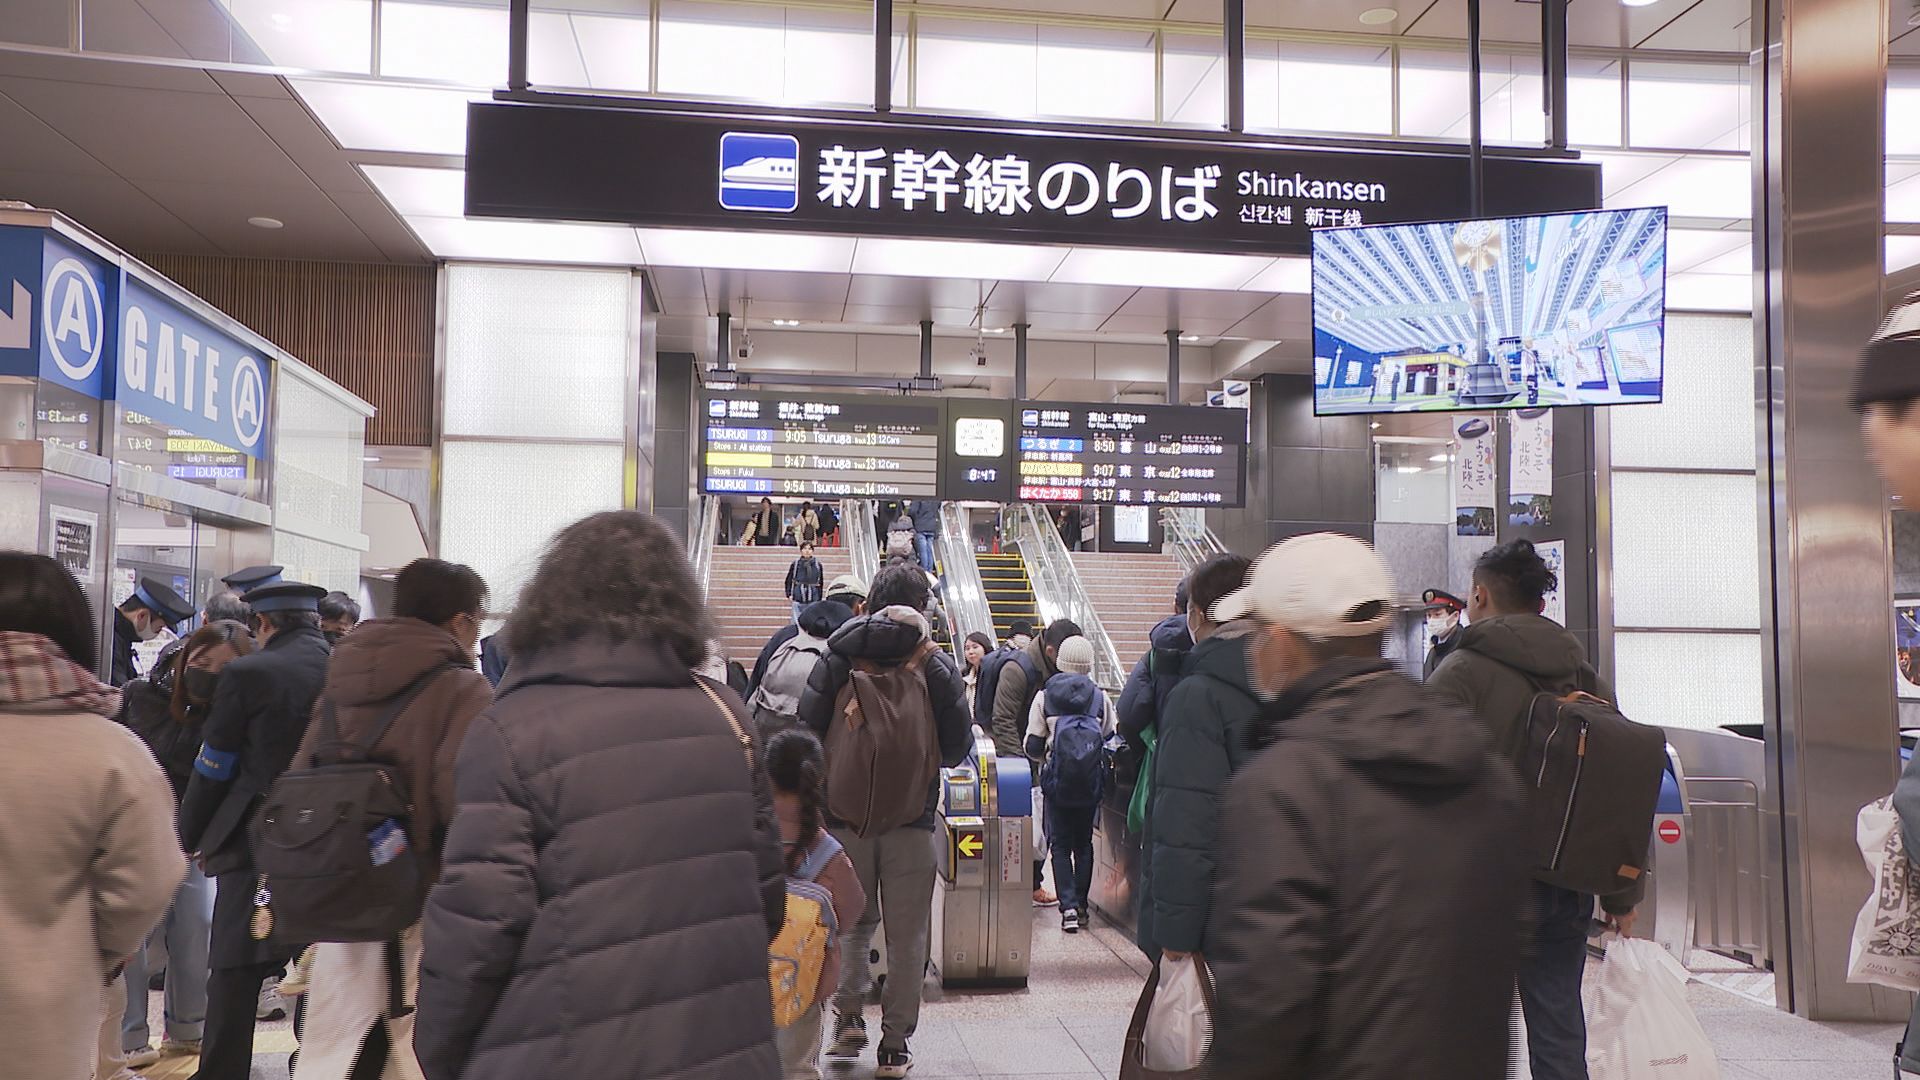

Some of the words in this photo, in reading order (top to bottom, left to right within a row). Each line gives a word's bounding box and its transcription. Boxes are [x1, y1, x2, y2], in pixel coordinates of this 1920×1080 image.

[817, 145, 1222, 221] 新幹線のりば
[1237, 170, 1386, 202] Shinkansen
[1238, 203, 1292, 225] 신칸센
[1304, 206, 1363, 227] 新干线
[124, 305, 220, 422] GATE
[1041, 410, 1070, 421] 新幹線
[1041, 420, 1070, 428] Shinkansen
[711, 429, 748, 440] TSURUGI
[756, 430, 768, 440] 13
[785, 430, 807, 443] 9:05
[813, 431, 852, 446] Tsuruga
[866, 432, 877, 445] 13
[1024, 438, 1060, 450] つるぎ
[1069, 439, 1075, 450] 2
[1094, 440, 1115, 453] 8:50
[713, 441, 731, 451] Stops
[739, 442, 748, 451] All
[749, 443, 772, 453] stations
[1535, 421, 1544, 471] ようこそ
[784, 455, 806, 468] 9:47
[812, 456, 851, 470] Tsuruga
[866, 457, 876, 470] 13
[1476, 439, 1486, 486] ようこそ
[1519, 441, 1530, 476] 北陸へ
[713, 467, 731, 476] Stops
[738, 468, 754, 477] Fukui
[969, 468, 996, 481] 8:47
[1093, 464, 1115, 477] 9:07
[1463, 458, 1474, 491] 北陸へ
[710, 479, 747, 490] TSURUGI
[755, 480, 766, 491] 15
[783, 480, 805, 493] 9:54
[812, 481, 851, 495] Tsuruga
[865, 482, 875, 495] 14
[1020, 487, 1060, 500] はくたか
[1093, 488, 1114, 502] 9:17
